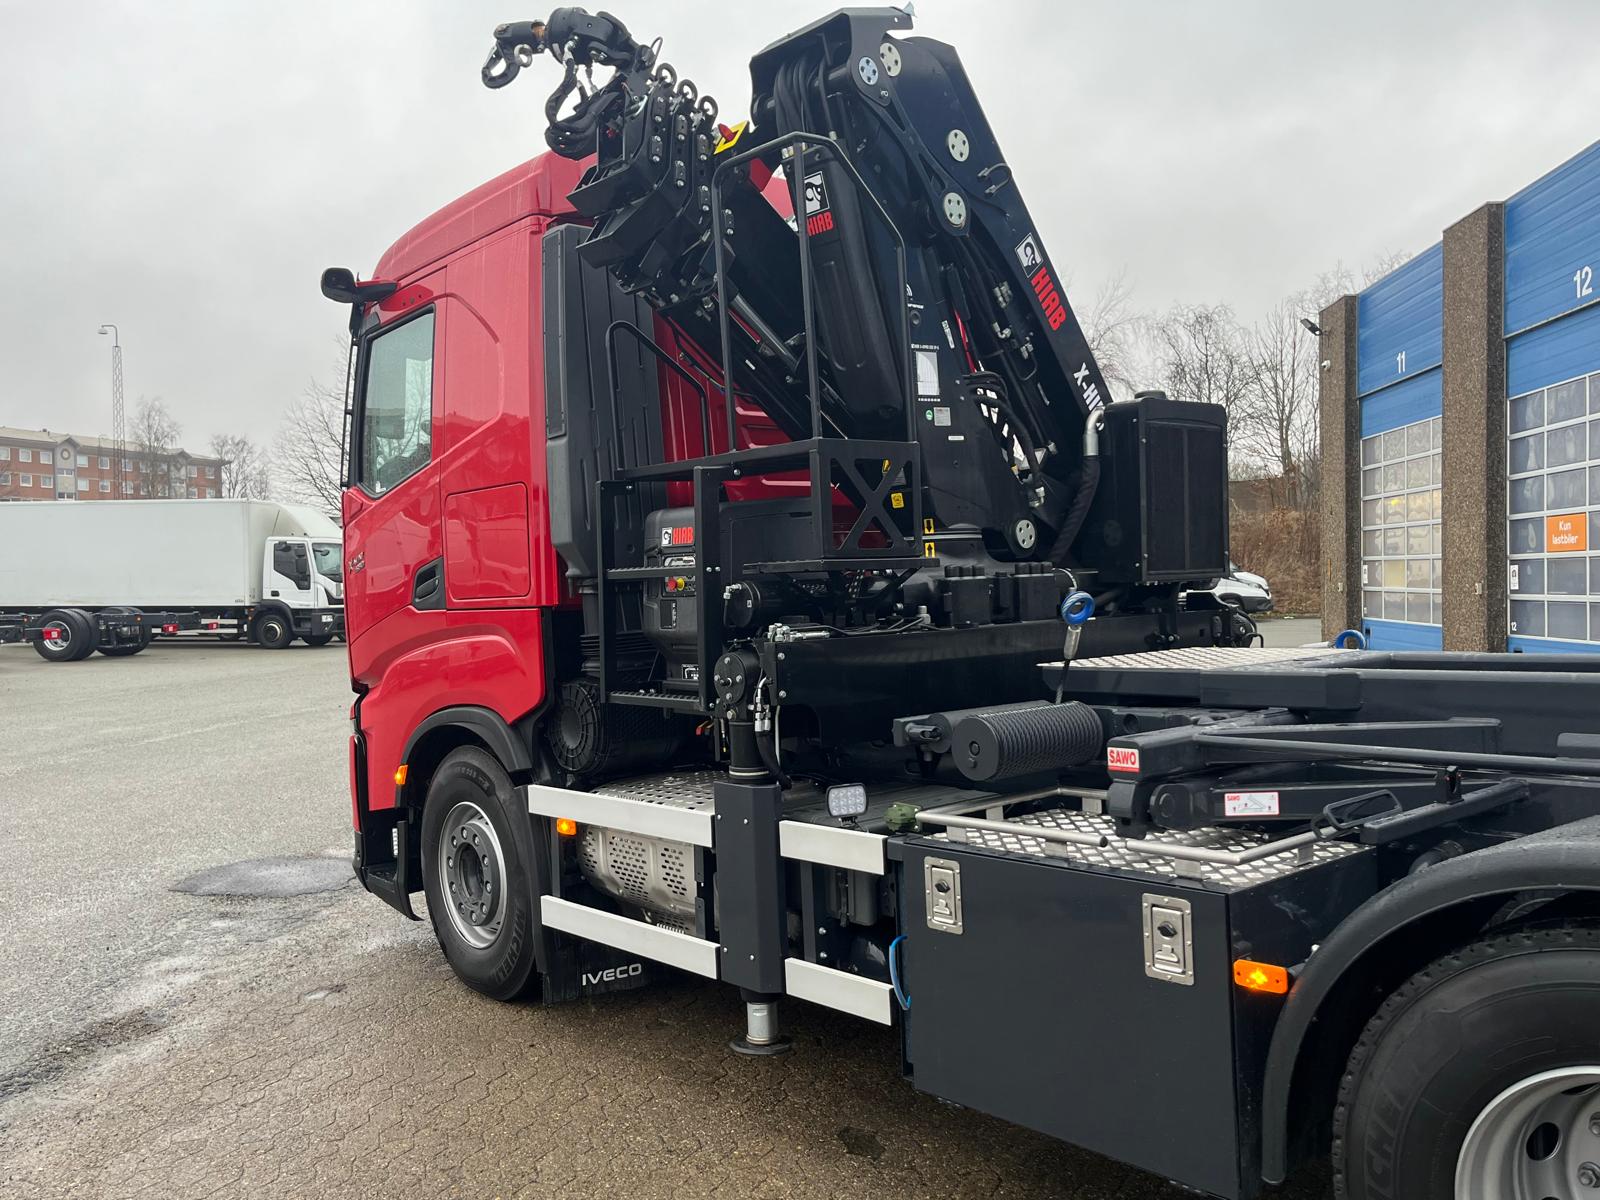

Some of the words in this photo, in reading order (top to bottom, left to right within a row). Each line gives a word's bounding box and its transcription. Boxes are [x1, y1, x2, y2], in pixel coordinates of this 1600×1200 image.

[807, 211, 833, 237] HIAB
[1573, 265, 1593, 298] 12
[1031, 266, 1067, 331] HIAB
[1396, 350, 1406, 374] 11
[672, 526, 694, 545] HIAB
[1559, 520, 1572, 531] Kun
[1551, 533, 1579, 545] lastbiler
[1510, 621, 1518, 632] 12
[1108, 749, 1137, 766] SAWO
[582, 963, 642, 986] IVECO
